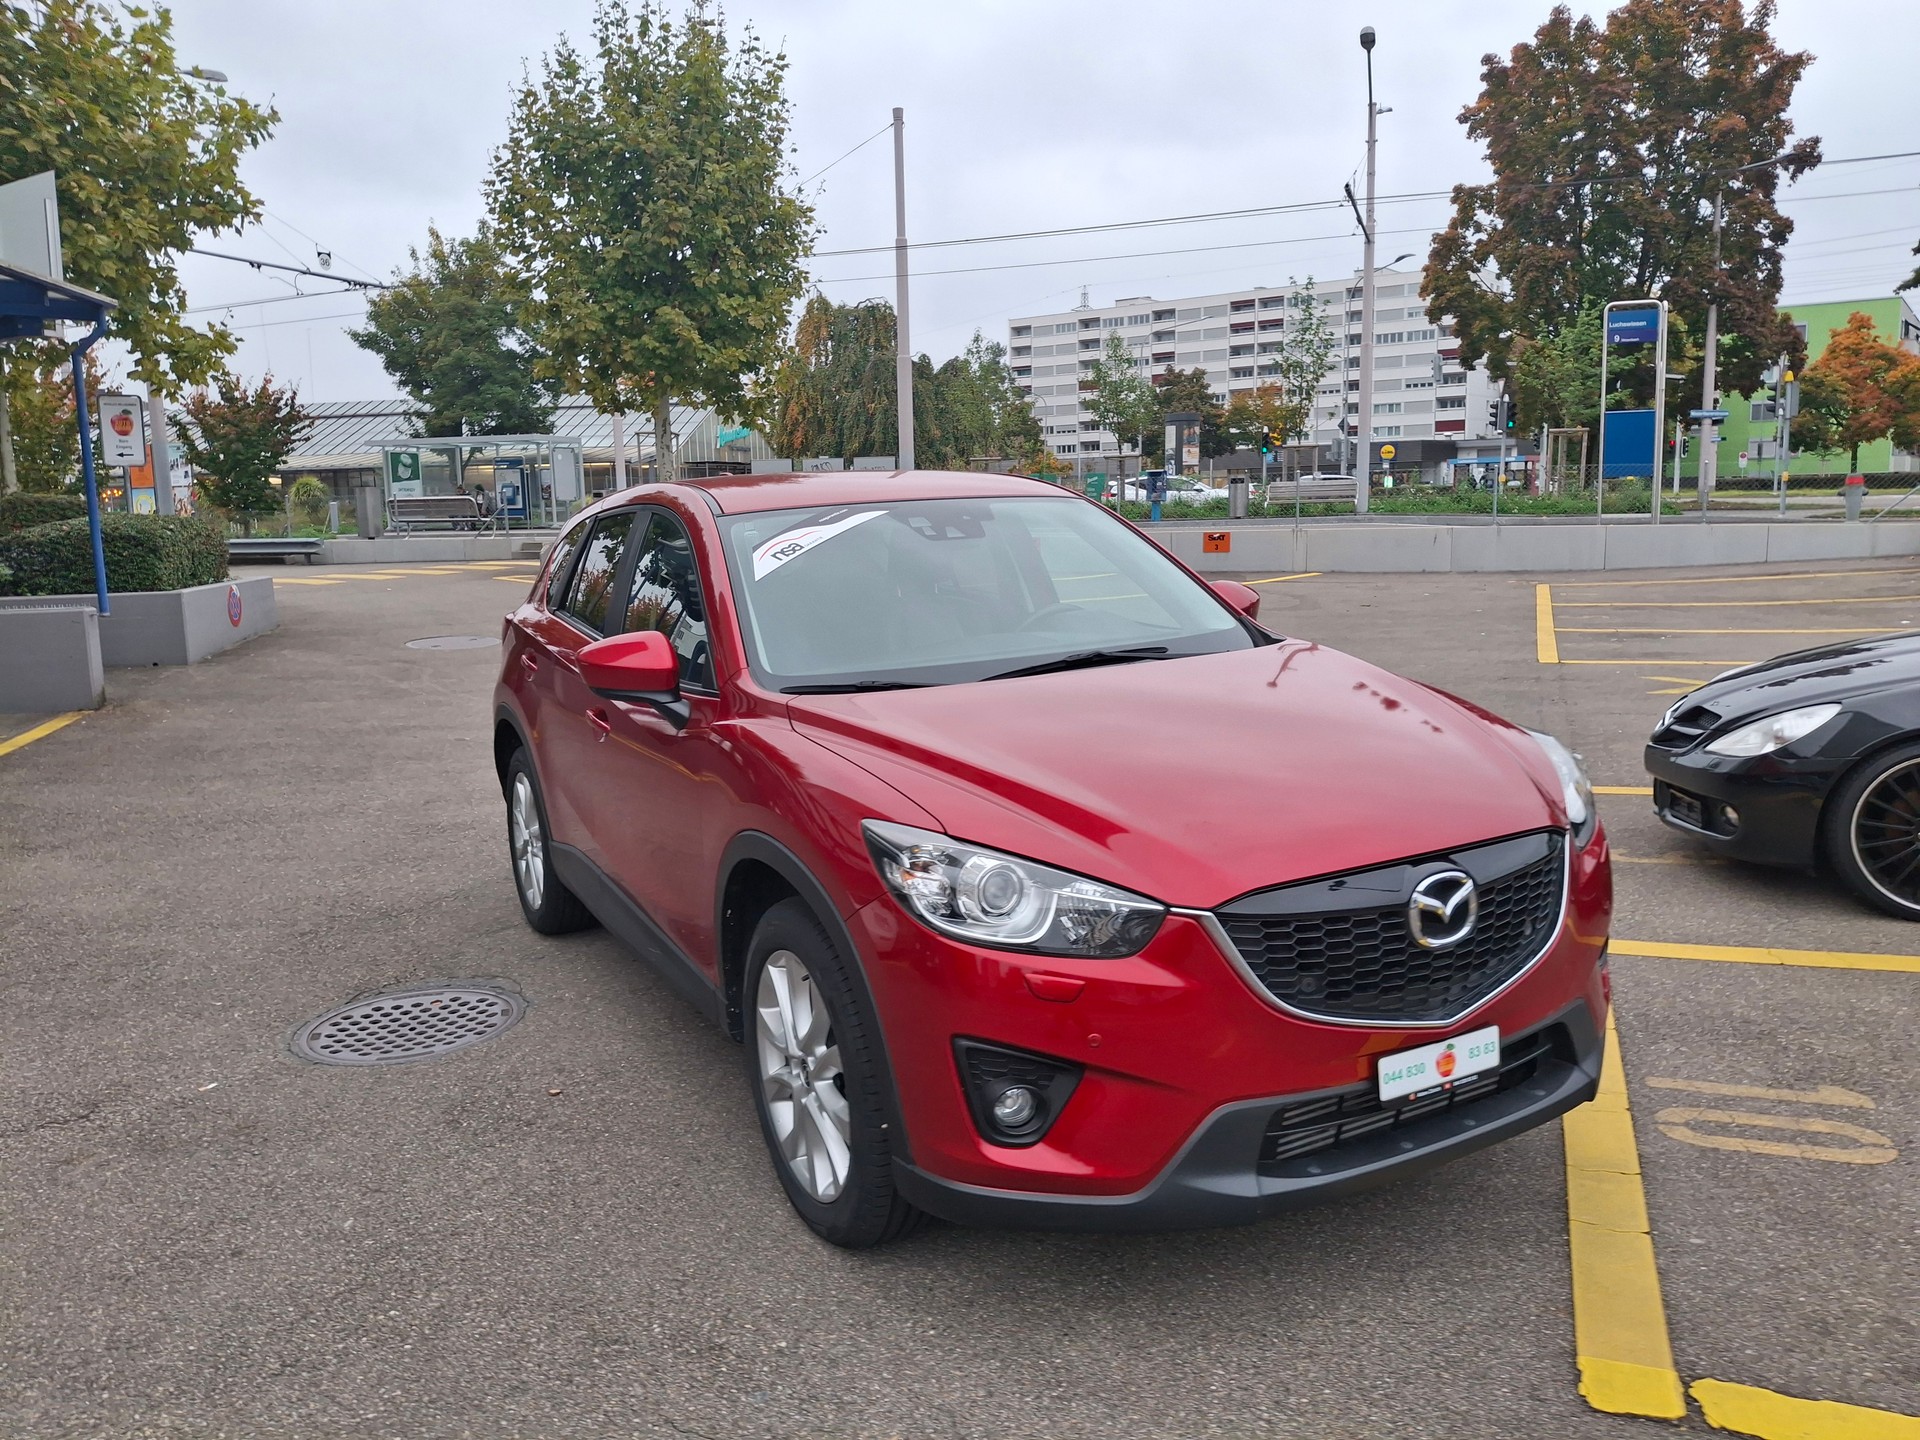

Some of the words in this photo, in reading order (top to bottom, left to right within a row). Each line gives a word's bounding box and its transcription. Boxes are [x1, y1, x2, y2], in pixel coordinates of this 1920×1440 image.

[320, 257, 330, 267] 36
[1608, 320, 1647, 329] Luchswiesen
[1613, 334, 1620, 343] 9
[770, 542, 805, 561] nsa
[1214, 543, 1219, 551] 3
[1383, 1068, 1403, 1085] 044
[1405, 1062, 1427, 1078] 830
[1468, 1046, 1481, 1059] 83
[1483, 1041, 1496, 1055] 83
